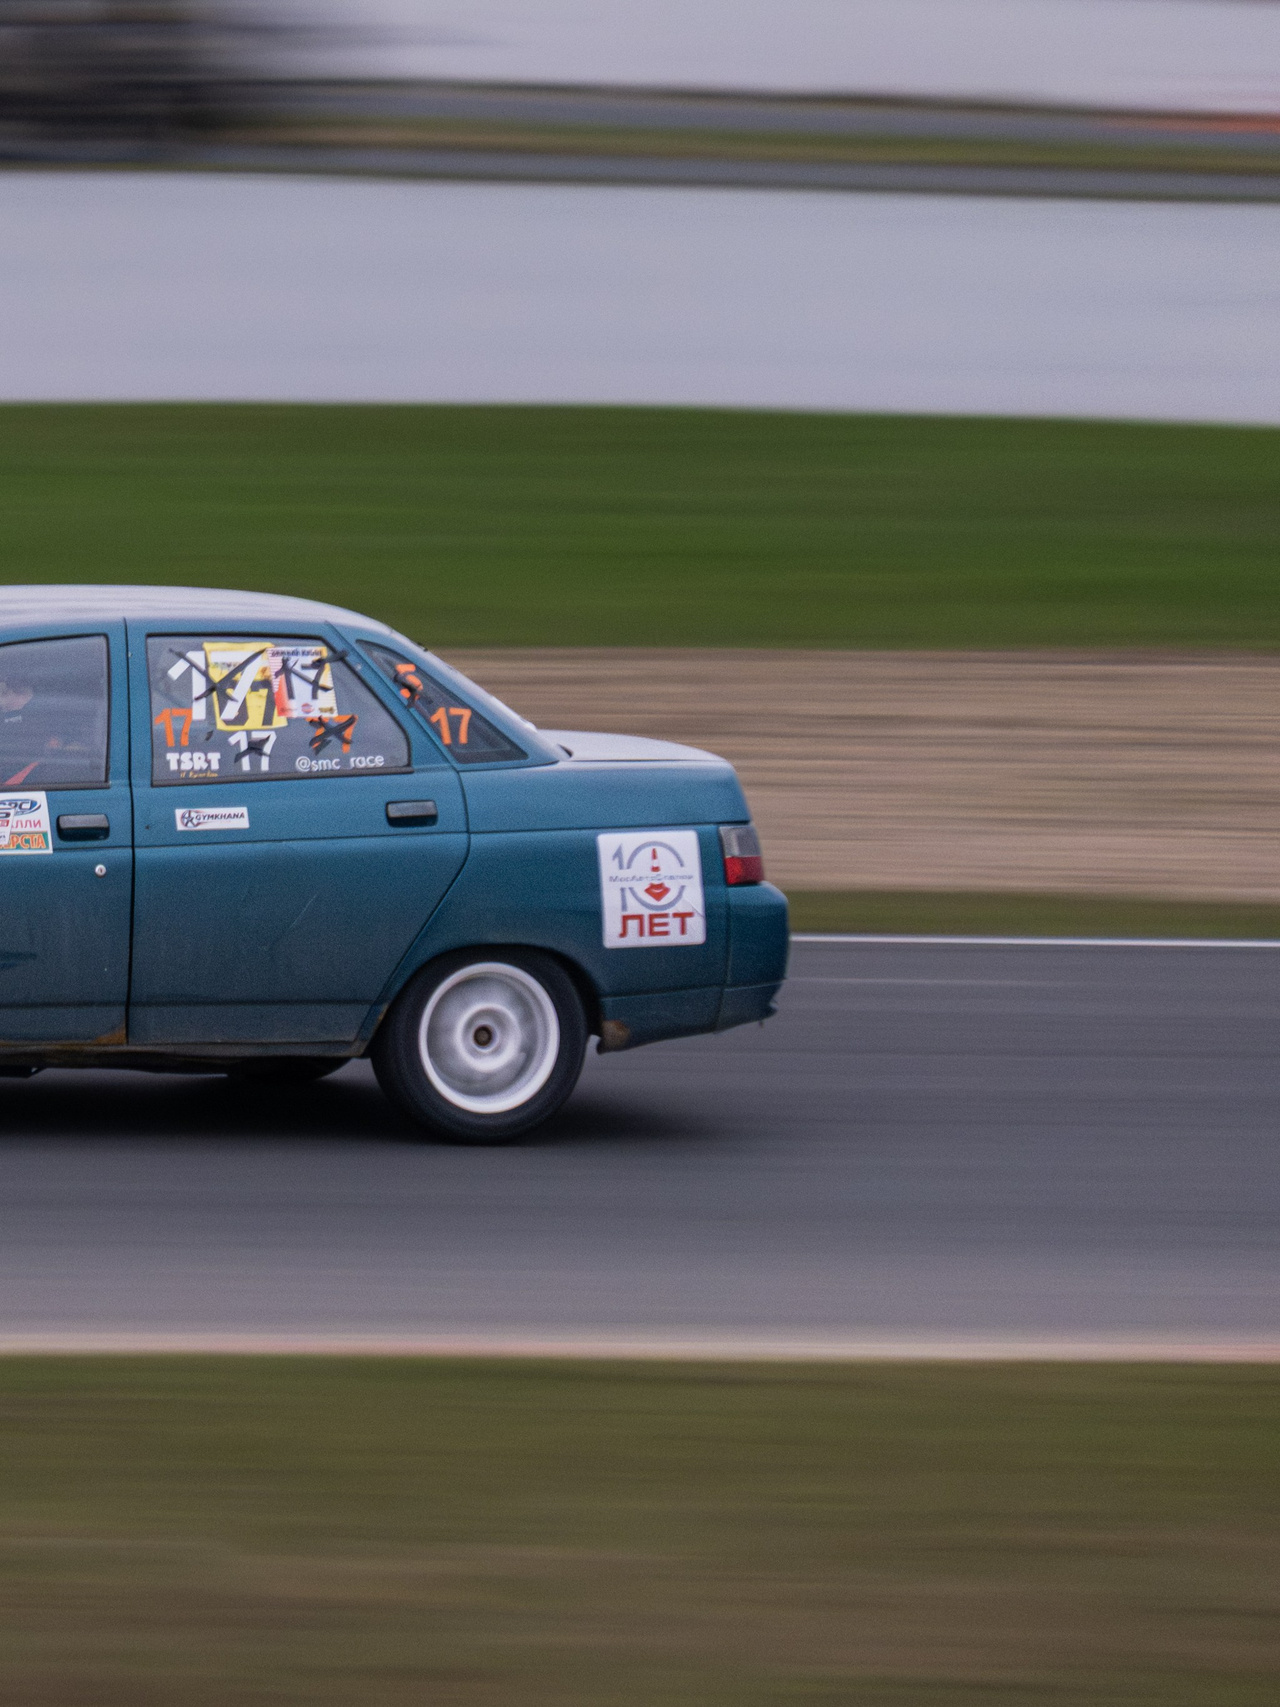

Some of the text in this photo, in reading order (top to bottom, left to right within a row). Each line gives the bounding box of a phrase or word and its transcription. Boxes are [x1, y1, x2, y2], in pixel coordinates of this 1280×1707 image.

[154, 708, 193, 747] 17
[430, 706, 472, 745] 17
[166, 752, 221, 771] TSRT
[195, 812, 245, 821] GYMKHANA
[618, 911, 695, 938] ЛЕТ
